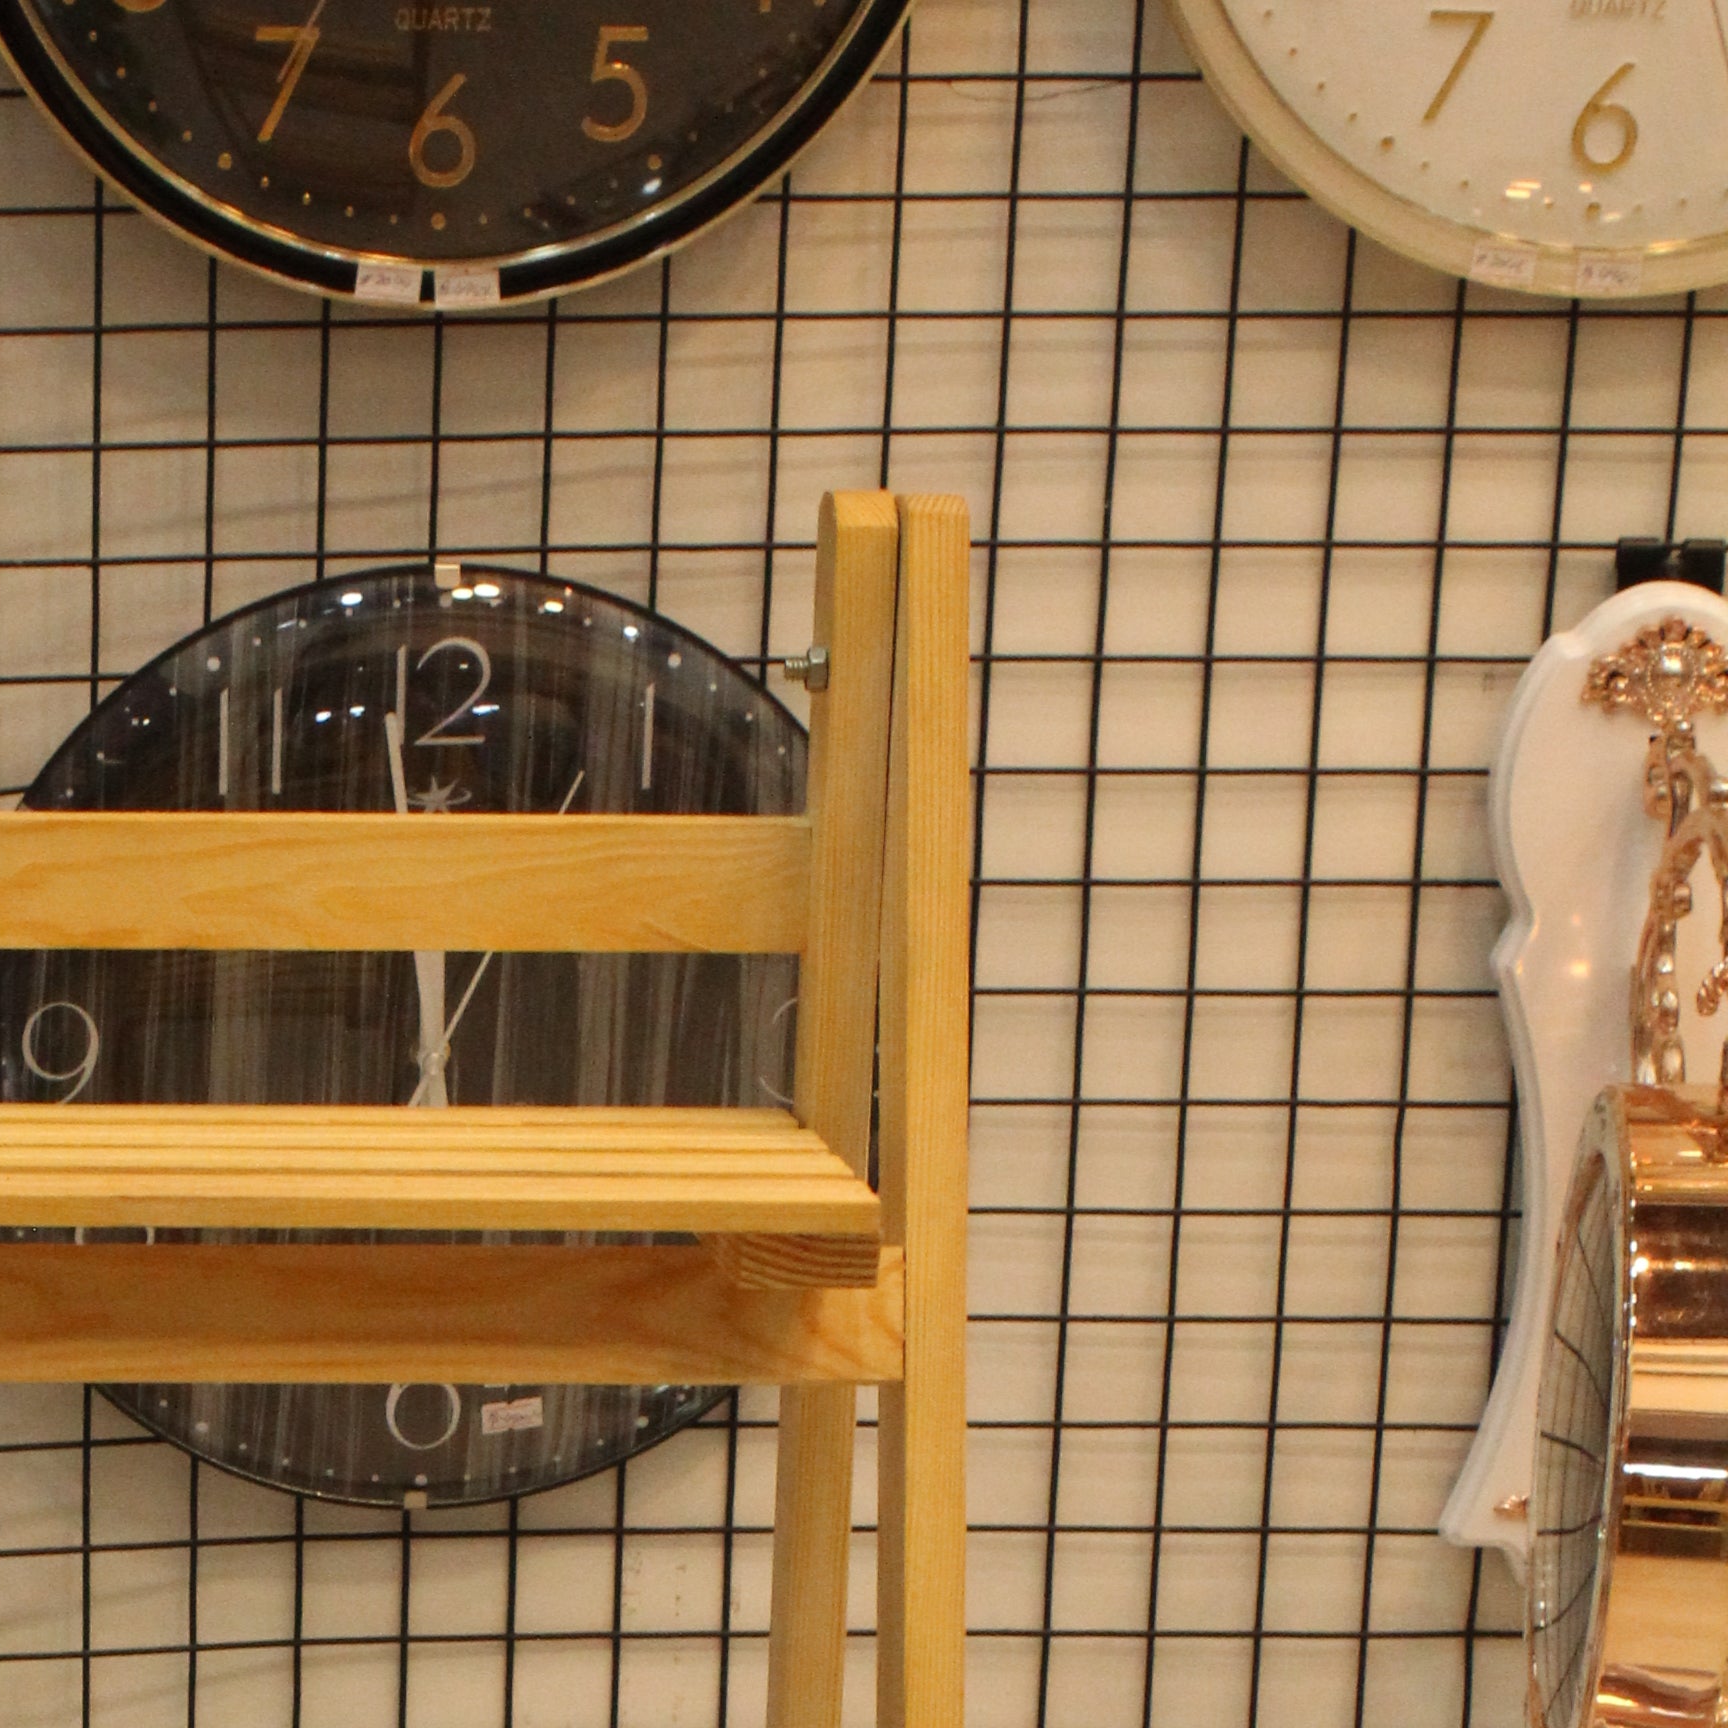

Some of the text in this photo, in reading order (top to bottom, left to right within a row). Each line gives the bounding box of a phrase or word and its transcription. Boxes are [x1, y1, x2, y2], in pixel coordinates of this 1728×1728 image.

[394, 6, 492, 32] QUARTZ
[1422, 10, 1495, 122] 7
[254, 26, 321, 143] 7
[407, 73, 474, 188] 6
[580, 25, 649, 143] 5
[1571, 62, 1638, 174] 6
[219, 686, 283, 796] 11
[397, 636, 492, 747] 12
[22, 1002, 100, 1106] 9
